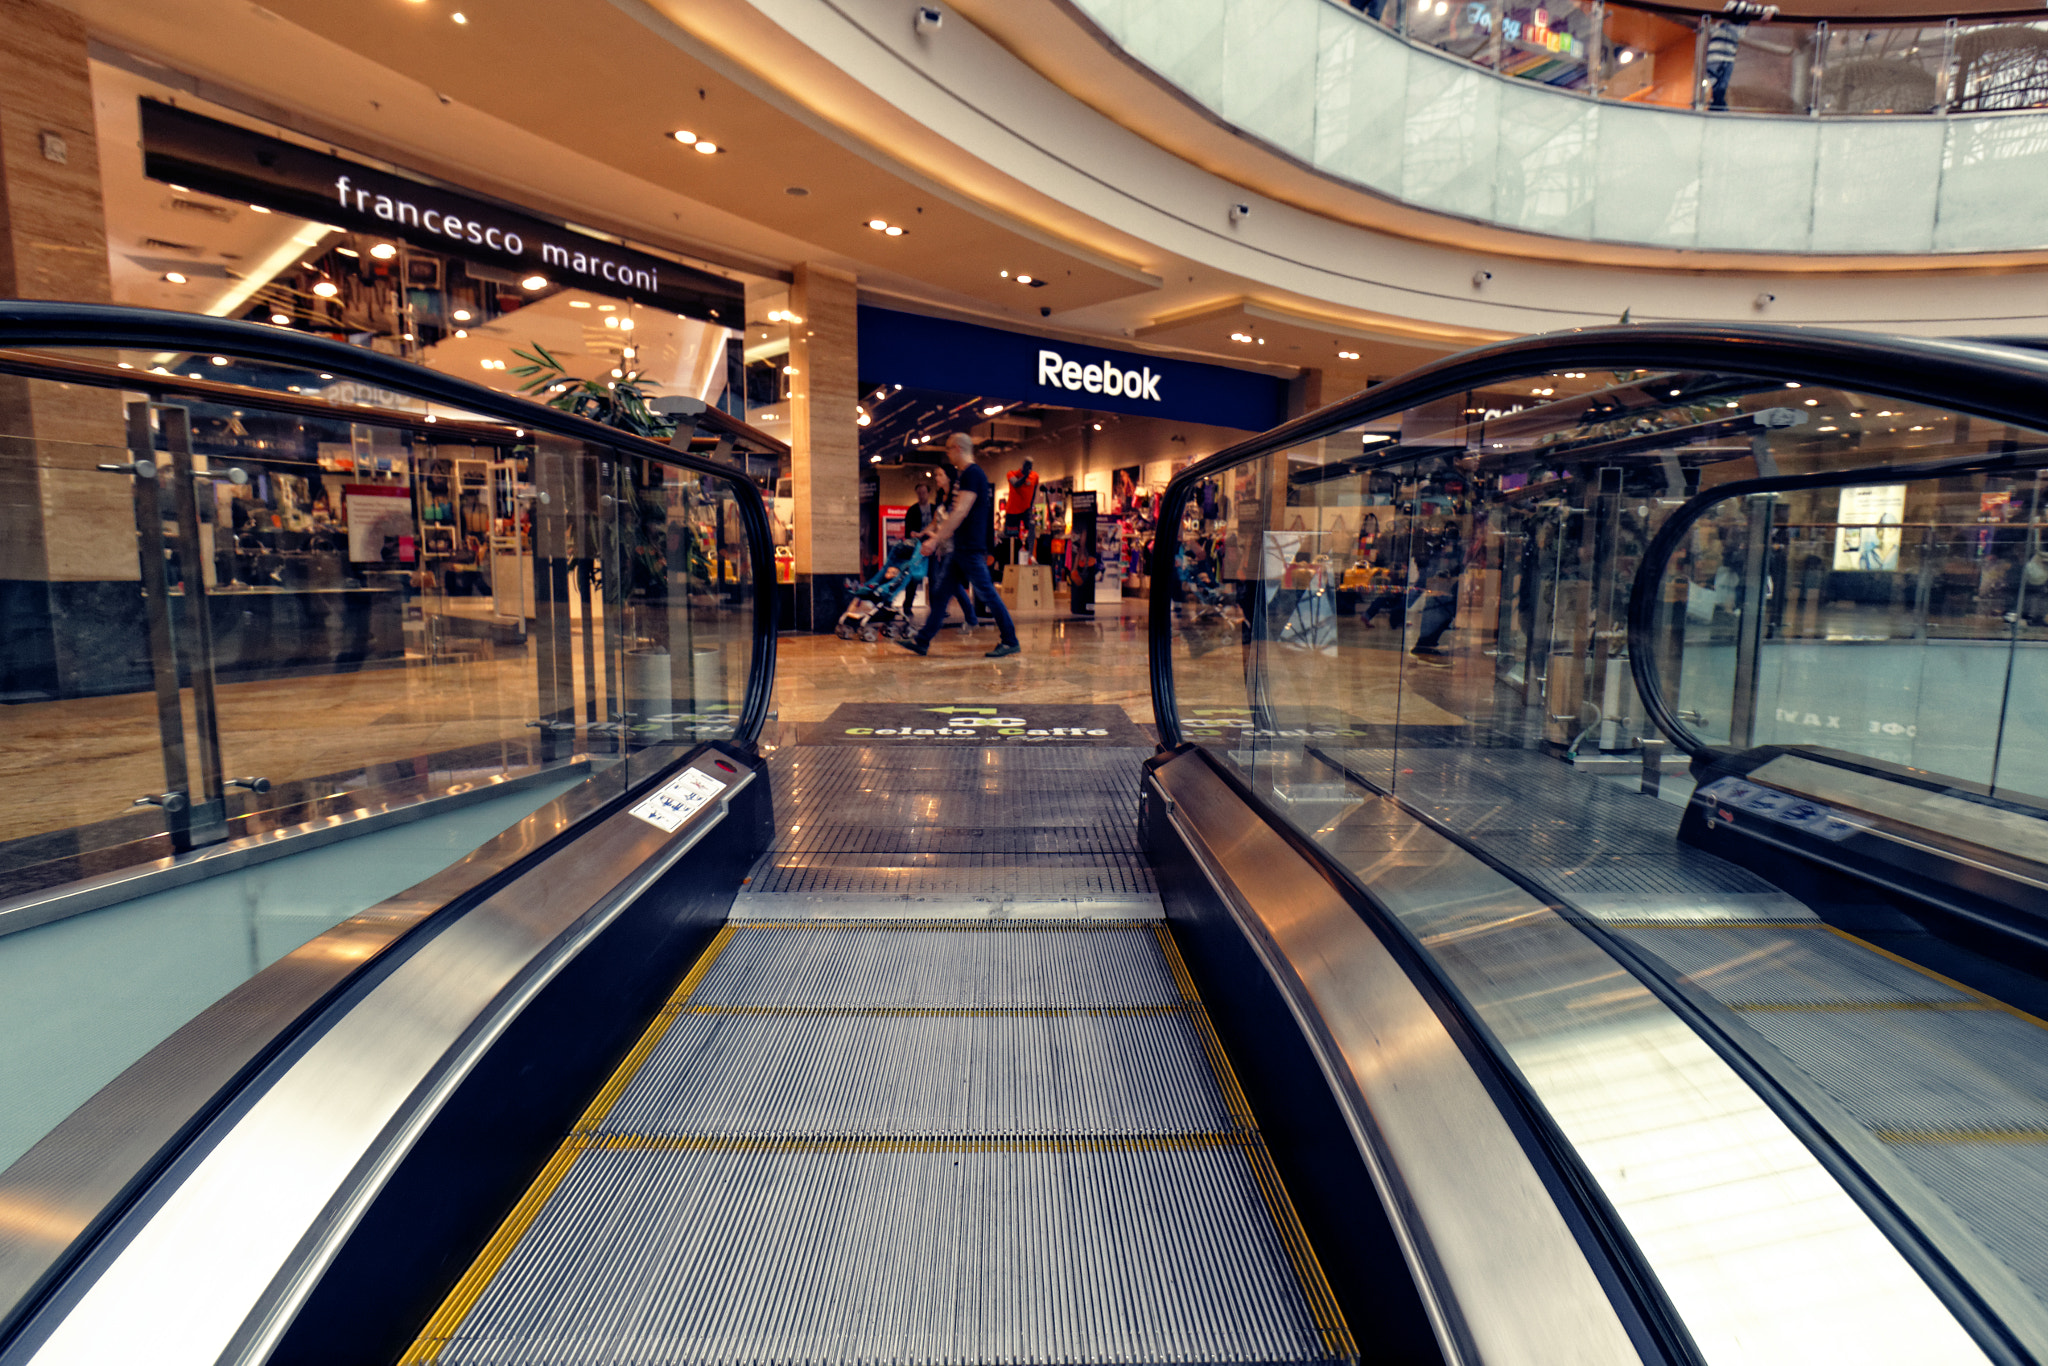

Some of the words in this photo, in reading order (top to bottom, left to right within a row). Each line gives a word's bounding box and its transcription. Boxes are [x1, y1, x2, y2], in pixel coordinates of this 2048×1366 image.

[335, 176, 524, 256] francesco
[542, 242, 659, 293] marconi
[1038, 350, 1162, 402] Reebok
[845, 726, 977, 736] Gelato
